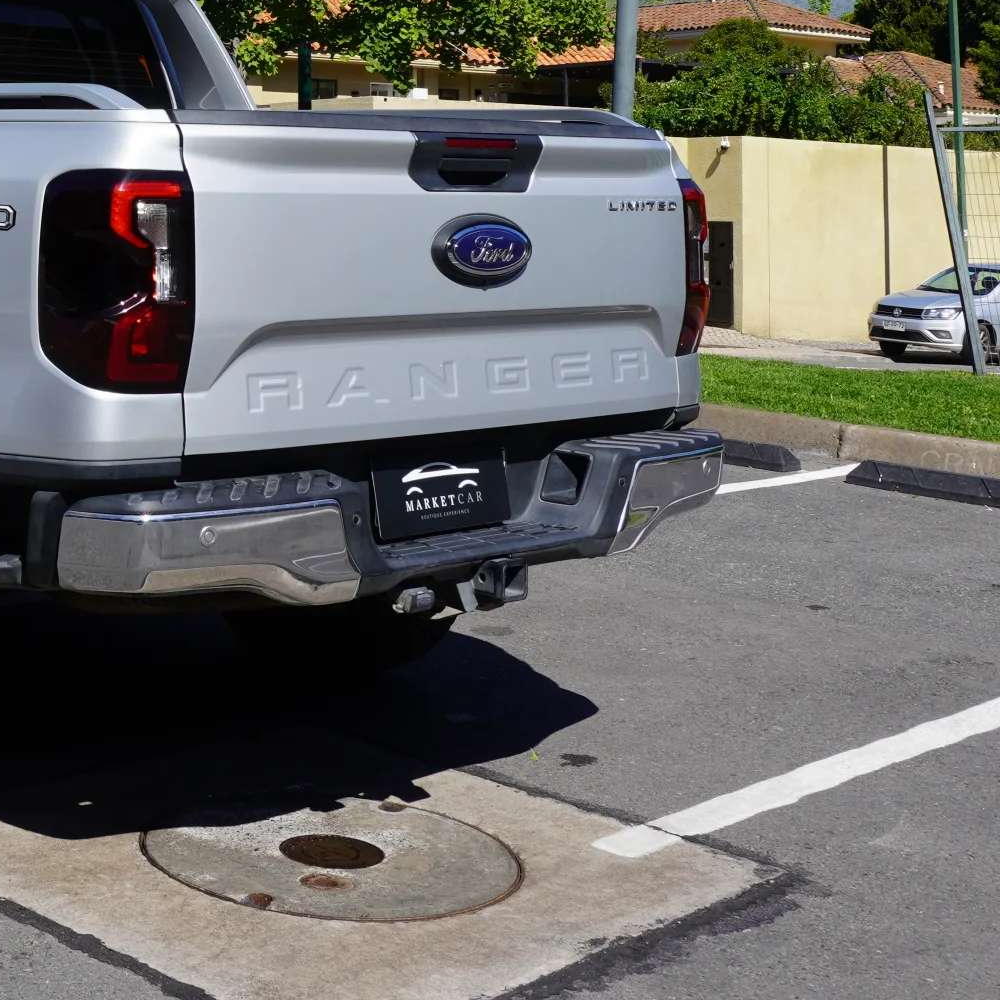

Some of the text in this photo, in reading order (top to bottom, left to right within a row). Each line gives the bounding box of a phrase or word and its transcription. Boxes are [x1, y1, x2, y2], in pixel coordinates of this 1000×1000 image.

[607, 199, 677, 212] LIMITED
[470, 235, 514, 263] Ford
[246, 347, 650, 414] RANGER
